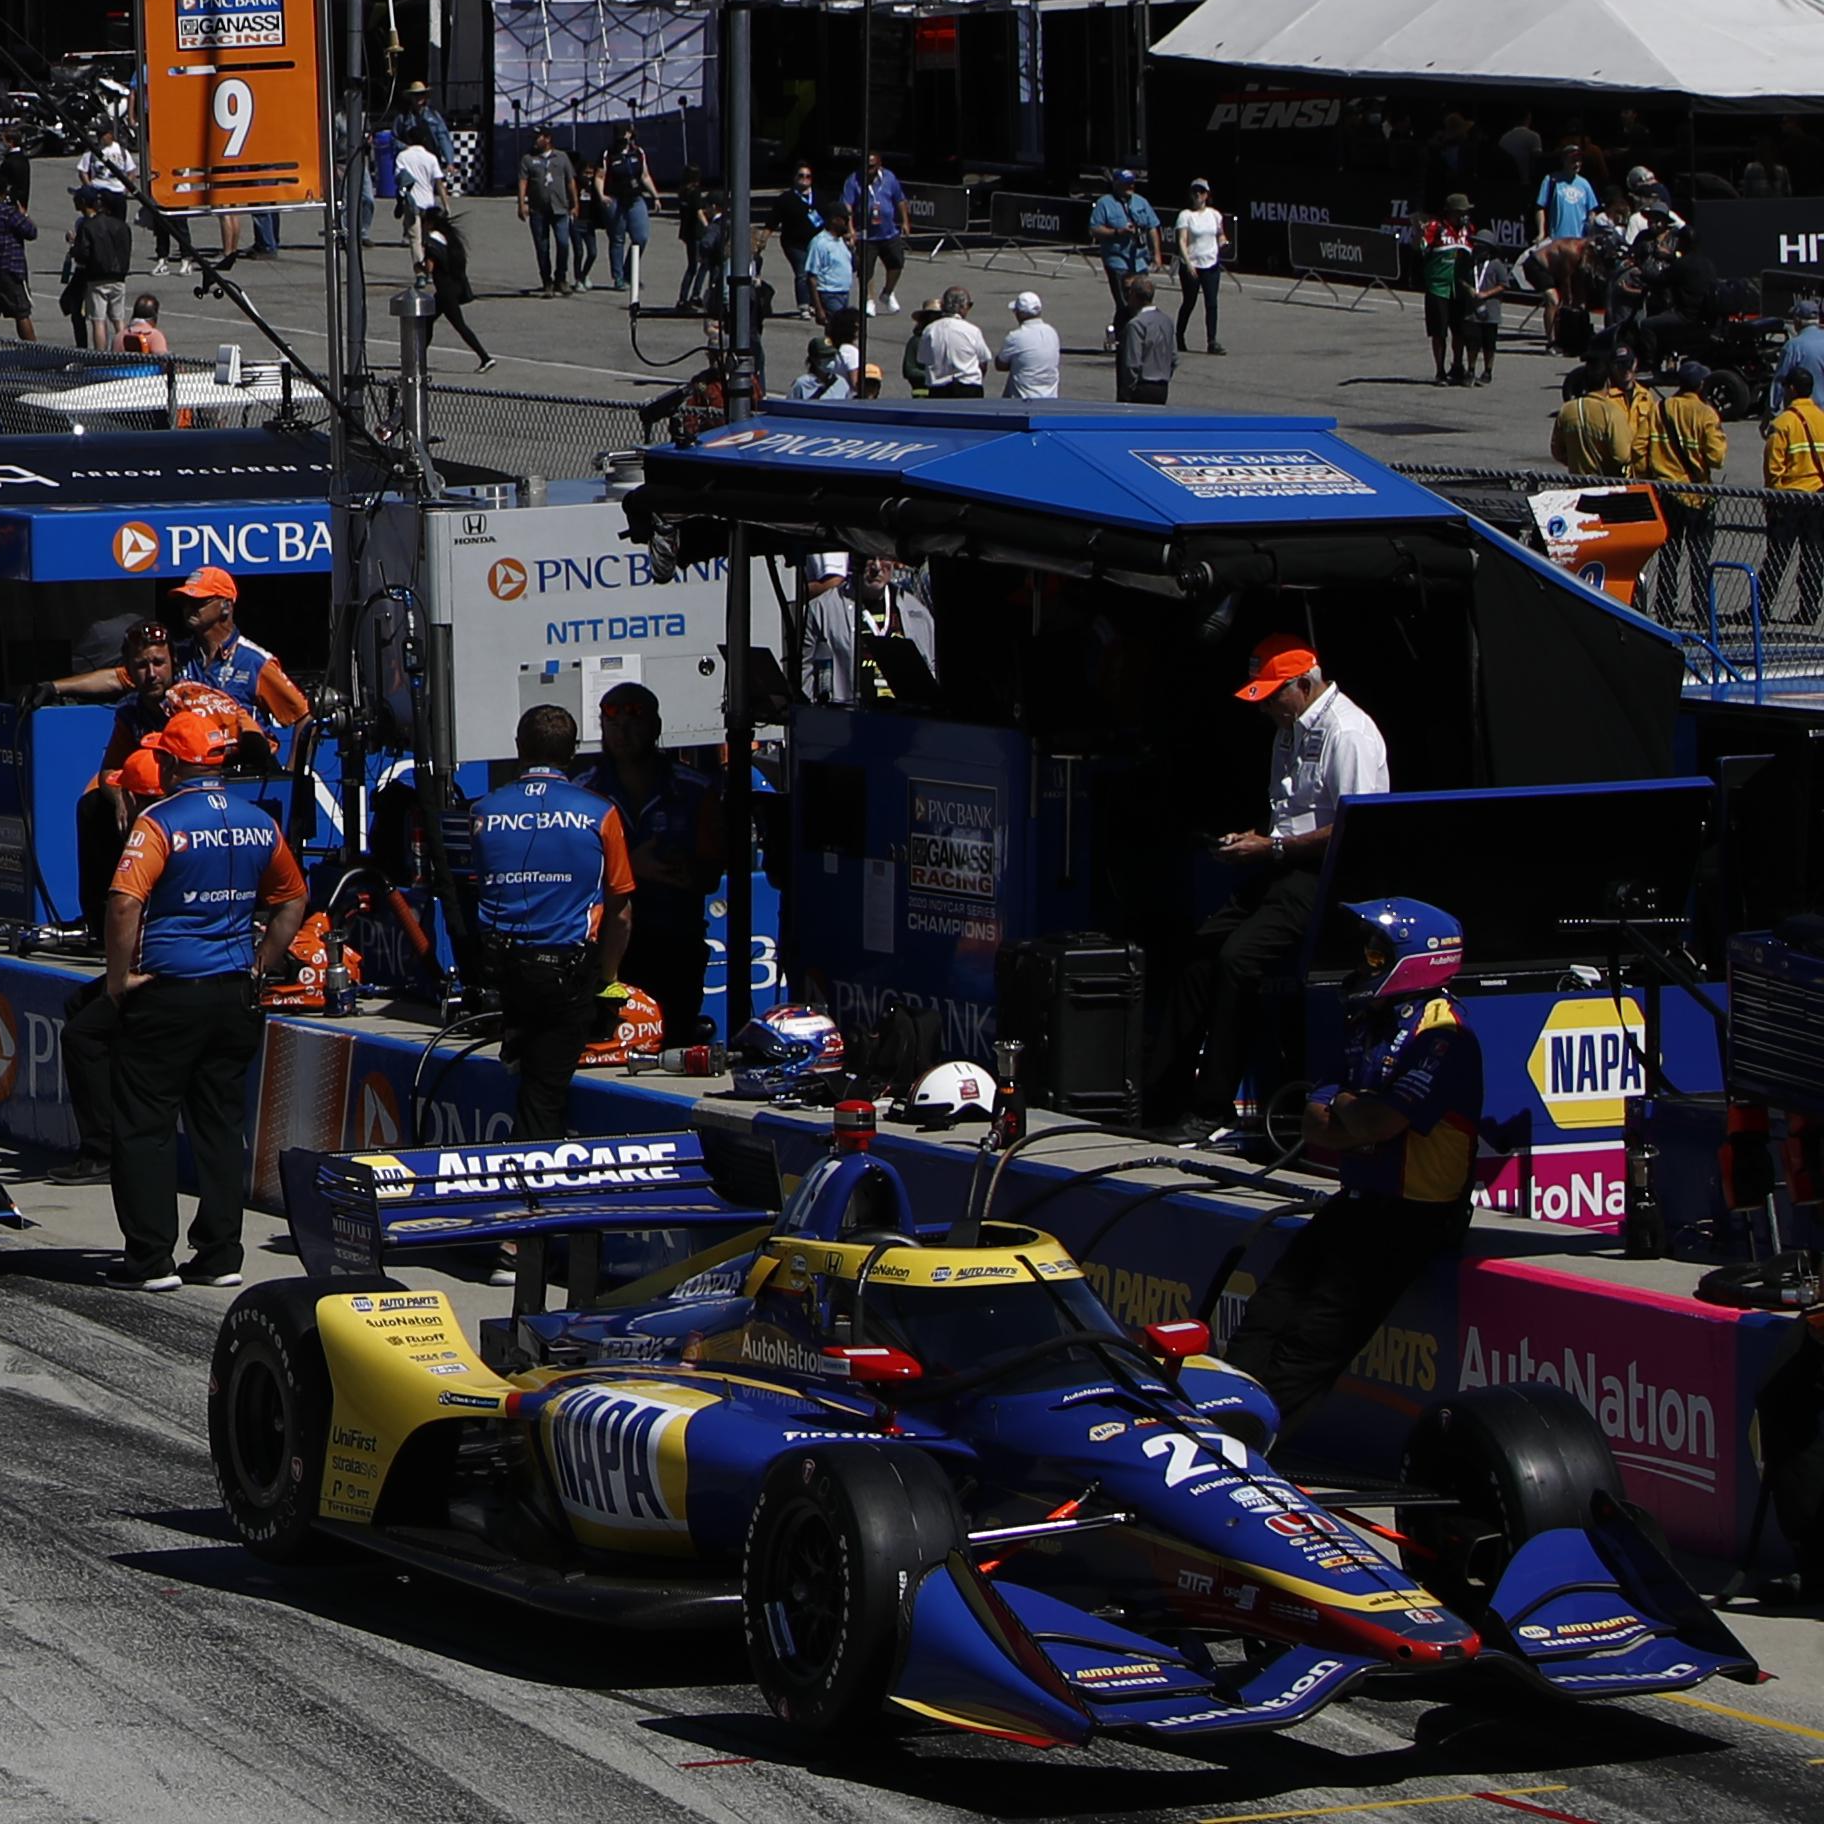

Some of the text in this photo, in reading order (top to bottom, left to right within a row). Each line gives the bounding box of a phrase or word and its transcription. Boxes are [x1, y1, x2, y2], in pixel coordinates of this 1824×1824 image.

[199, 14, 281, 36] GANASSI
[181, 33, 282, 47] RACING
[212, 77, 254, 158] 9
[1019, 209, 1061, 231] verizon
[1251, 200, 1331, 225] MENARDS
[1319, 238, 1364, 263] verizon
[740, 432, 938, 462] PNC BANK
[1179, 454, 1317, 465] PNC BANK
[71, 464, 298, 480] ARROW McLAREN
[1193, 487, 1378, 499] CHAMPIONS
[166, 522, 269, 567] PNC
[453, 535, 498, 546] HONDA
[536, 556, 625, 591] PNC
[546, 612, 686, 645] NTT DATA
[487, 811, 596, 832] PNC BANK
[927, 799, 993, 829] PNC BANK
[191, 828, 274, 849] PNC BANK
[927, 838, 993, 875] GANASSI
[911, 866, 993, 893] RACING
[907, 912, 996, 941] CHAMPIONS
[1551, 1031, 1643, 1094] NAPA
[435, 1142, 682, 1196] AUTOCARE
[956, 1266, 1018, 1278] AUTO PARTS
[378, 1295, 439, 1308] AUTO PARTS
[1114, 1274, 1193, 1324] PARTS
[405, 1332, 446, 1345] Ruoff
[1062, 1386, 1115, 1403] AutoNation
[331, 1426, 377, 1454] UniFirst
[331, 1454, 378, 1479] stratasys
[554, 1388, 670, 1522] NAPA
[1140, 1431, 1248, 1488] 27
[1177, 1570, 1213, 1595] DTR
[1556, 1615, 1638, 1635] AUTO PARTS
[1076, 1662, 1161, 1680] AUTO PARTS
